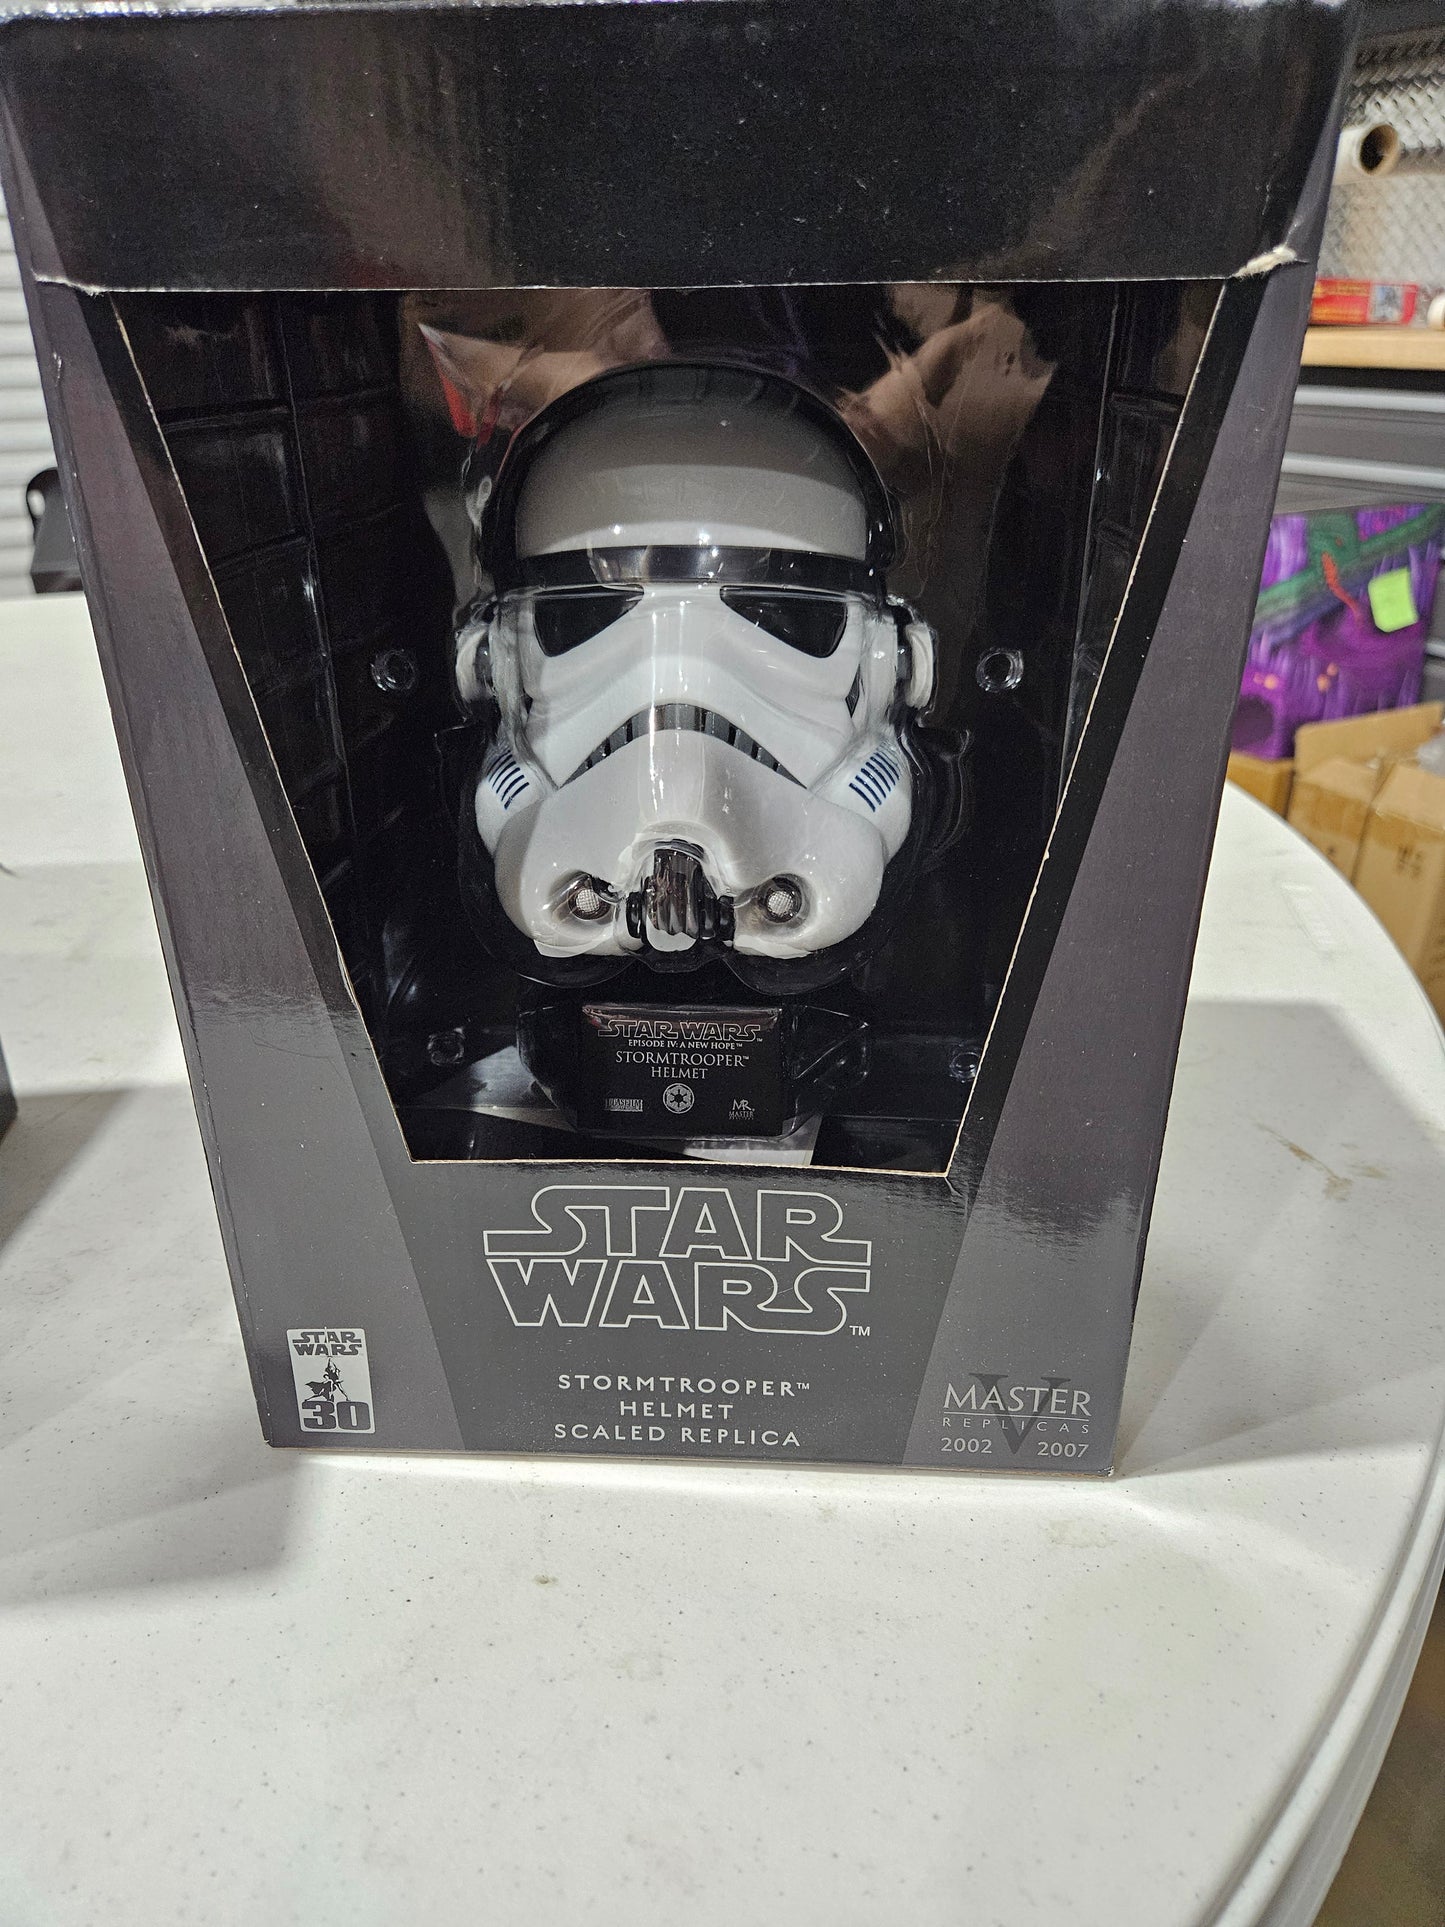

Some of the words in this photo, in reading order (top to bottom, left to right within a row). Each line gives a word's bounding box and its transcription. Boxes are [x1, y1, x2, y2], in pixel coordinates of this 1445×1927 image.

[597, 1019, 679, 1040] STAR
[679, 1022, 760, 1042] WARS
[628, 1039, 665, 1048] EPISODE
[667, 1041, 679, 1049] IV:
[651, 1066, 709, 1079] HELMET
[482, 1185, 872, 1266] STAR
[486, 1258, 871, 1336] WARS
[292, 1330, 362, 1344] STAR
[293, 1343, 362, 1357] WARS
[620, 1400, 734, 1420] HELMET
[943, 1382, 1092, 1417] MASTER
[301, 1400, 372, 1431] 30
[942, 1417, 1090, 1434] REPLICAS
[554, 1423, 666, 1442] SCALED
[681, 1427, 801, 1447] REPLICA
[940, 1437, 993, 1454] 2002
[1037, 1441, 1090, 1458] 2007
